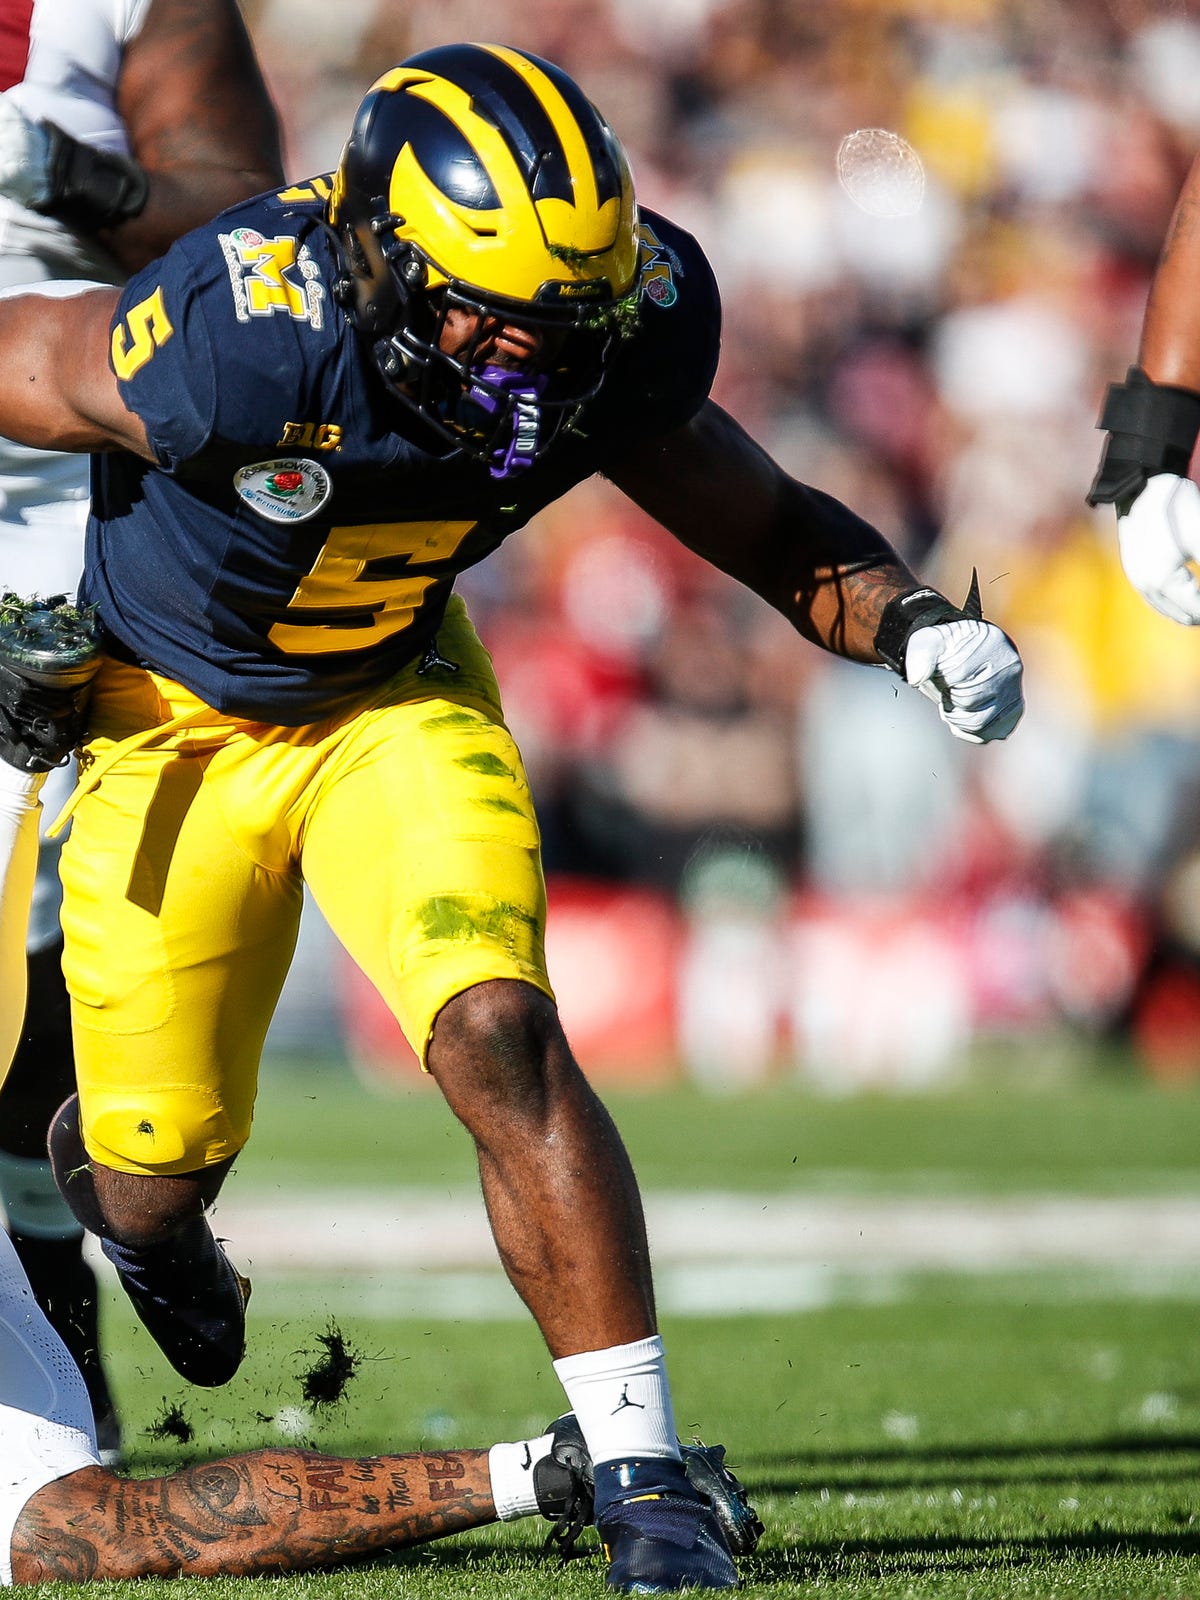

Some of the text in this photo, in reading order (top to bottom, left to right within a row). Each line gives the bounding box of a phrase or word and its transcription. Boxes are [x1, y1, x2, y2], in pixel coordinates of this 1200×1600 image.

[236, 236, 309, 321] M
[111, 286, 174, 381] 5
[240, 461, 326, 501] ROSE BOWL GAME
[267, 520, 478, 654] 5
[263, 1461, 301, 1503] Let
[302, 1452, 351, 1512] FAIT
